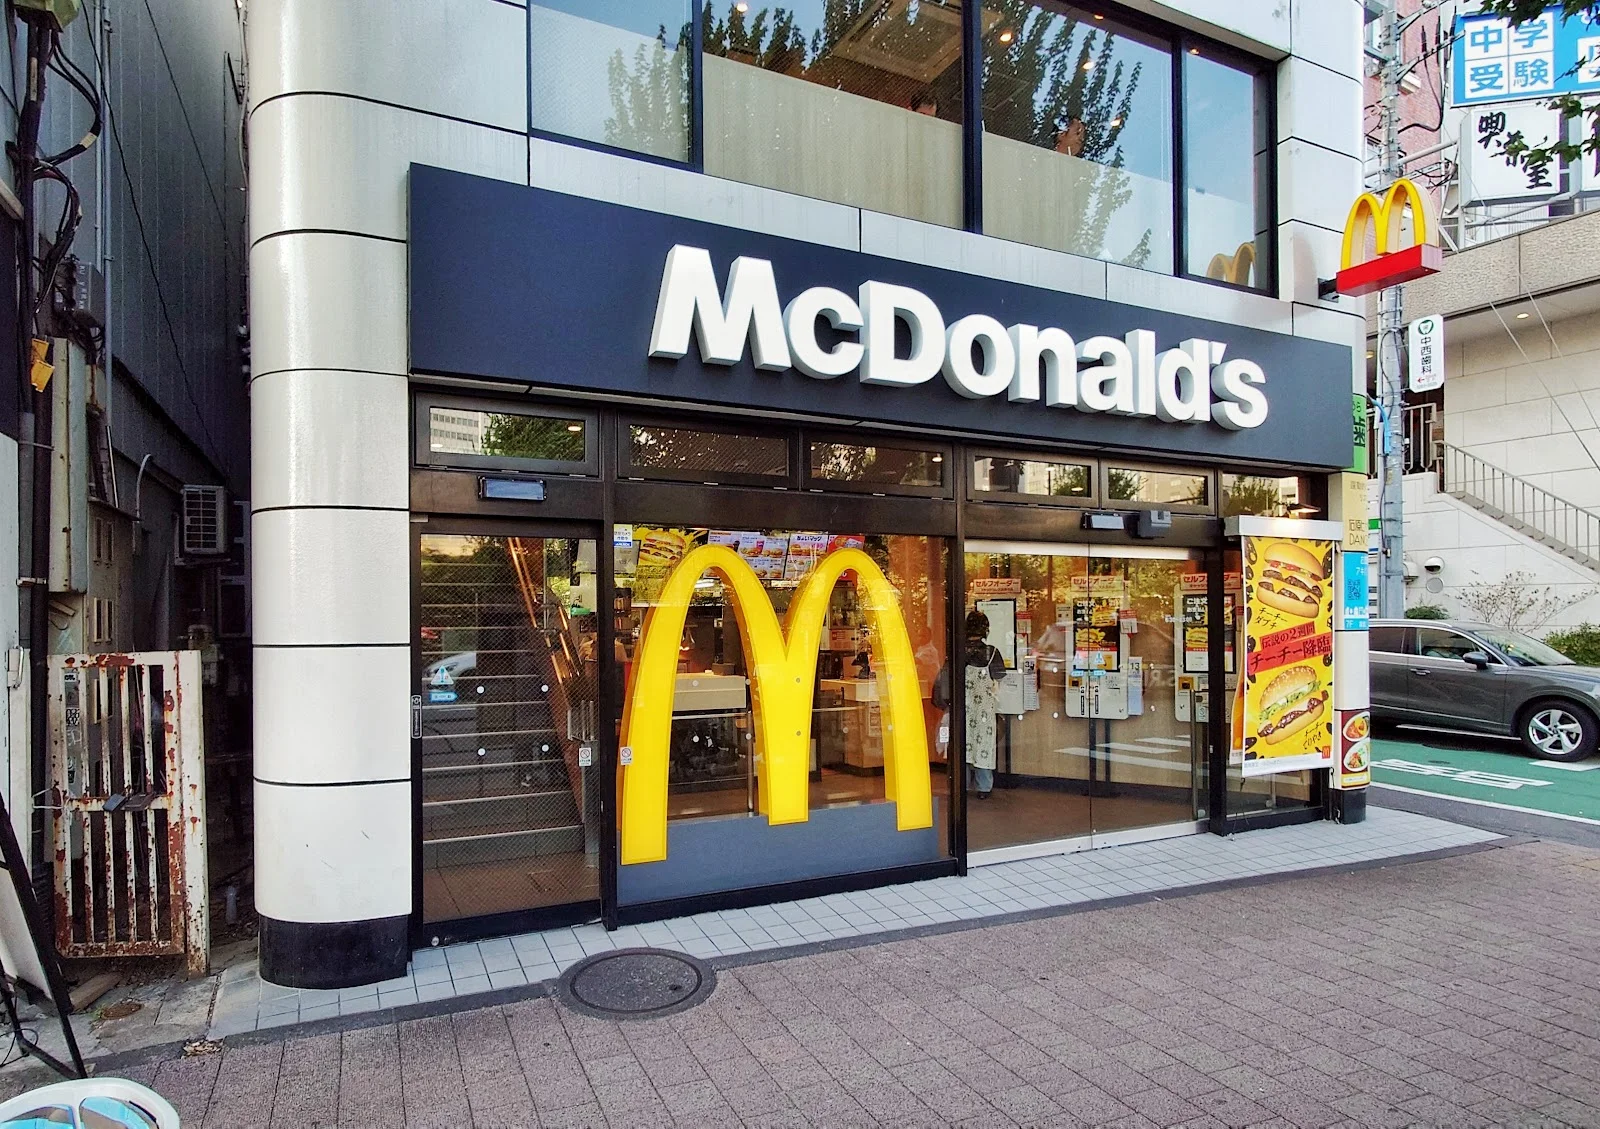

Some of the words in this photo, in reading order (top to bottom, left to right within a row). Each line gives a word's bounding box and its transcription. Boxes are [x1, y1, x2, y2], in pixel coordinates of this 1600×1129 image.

[1469, 58, 1549, 93] 受験
[648, 243, 1269, 431] McDonald's
[975, 579, 1019, 588] セルフオーダー
[1250, 634, 1331, 667] チーチー降臨
